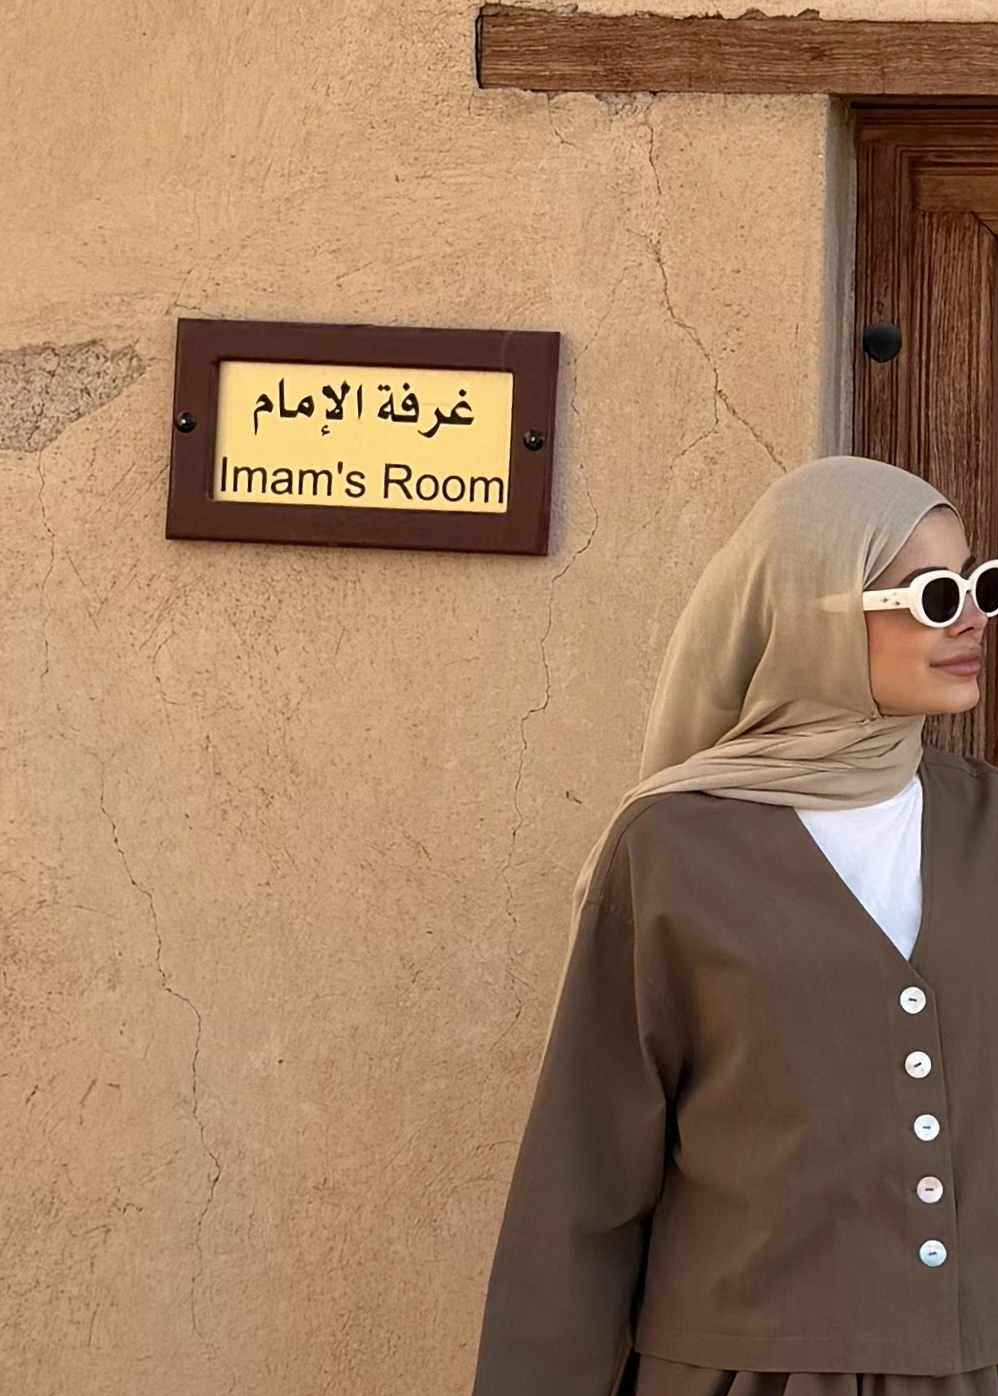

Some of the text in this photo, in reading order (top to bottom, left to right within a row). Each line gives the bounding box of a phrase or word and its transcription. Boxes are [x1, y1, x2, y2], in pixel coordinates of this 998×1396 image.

[254, 378, 474, 438] غرفة الإمام
[221, 457, 503, 503] Imam's Room
